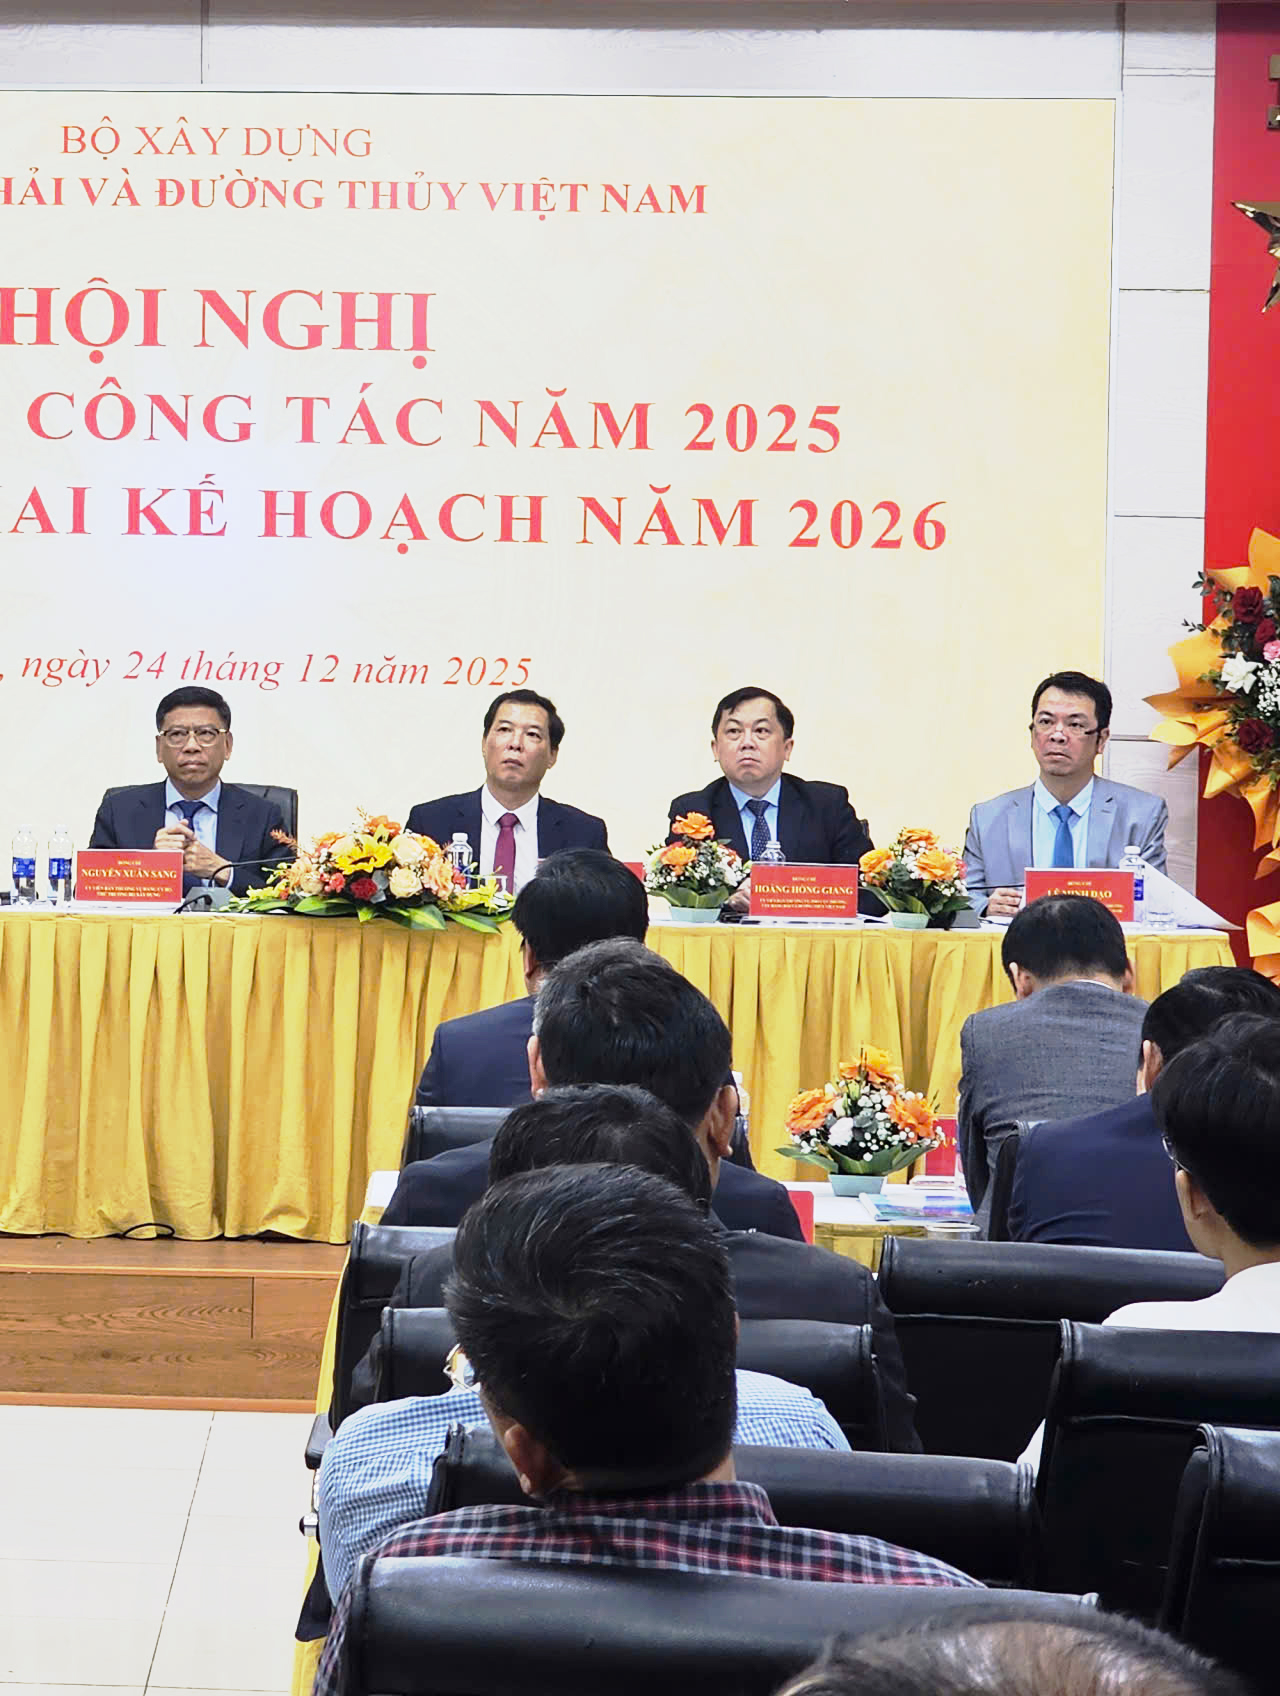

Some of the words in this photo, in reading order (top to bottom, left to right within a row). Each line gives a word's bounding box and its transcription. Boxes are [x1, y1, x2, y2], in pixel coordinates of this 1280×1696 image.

[62, 116, 120, 160] BỘ
[135, 116, 228, 155] XÂY
[244, 123, 372, 162] DỰNG
[79, 168, 140, 206] VÀ
[155, 169, 325, 209] ĐƯỜNG
[337, 170, 468, 212] THỦY
[479, 172, 590, 221] VIỆT
[601, 183, 708, 213] NAM
[195, 288, 436, 370] NGHỊ
[26, 376, 254, 442] CÔNG
[285, 381, 443, 446] TÁC
[475, 386, 653, 449] NĂM
[683, 402, 841, 453] 2025
[124, 472, 228, 536] KẾ
[260, 490, 548, 554] HOẠCH
[577, 483, 758, 547] NĂM
[788, 499, 947, 551] 2026
[21, 648, 110, 688] ngày
[123, 650, 167, 680] 24
[180, 650, 284, 690] tháng
[299, 653, 340, 683] 12
[352, 655, 429, 685] năm
[442, 656, 532, 687] 2025
[151, 870, 177, 879] SANG
[821, 886, 853, 896] GIANG
